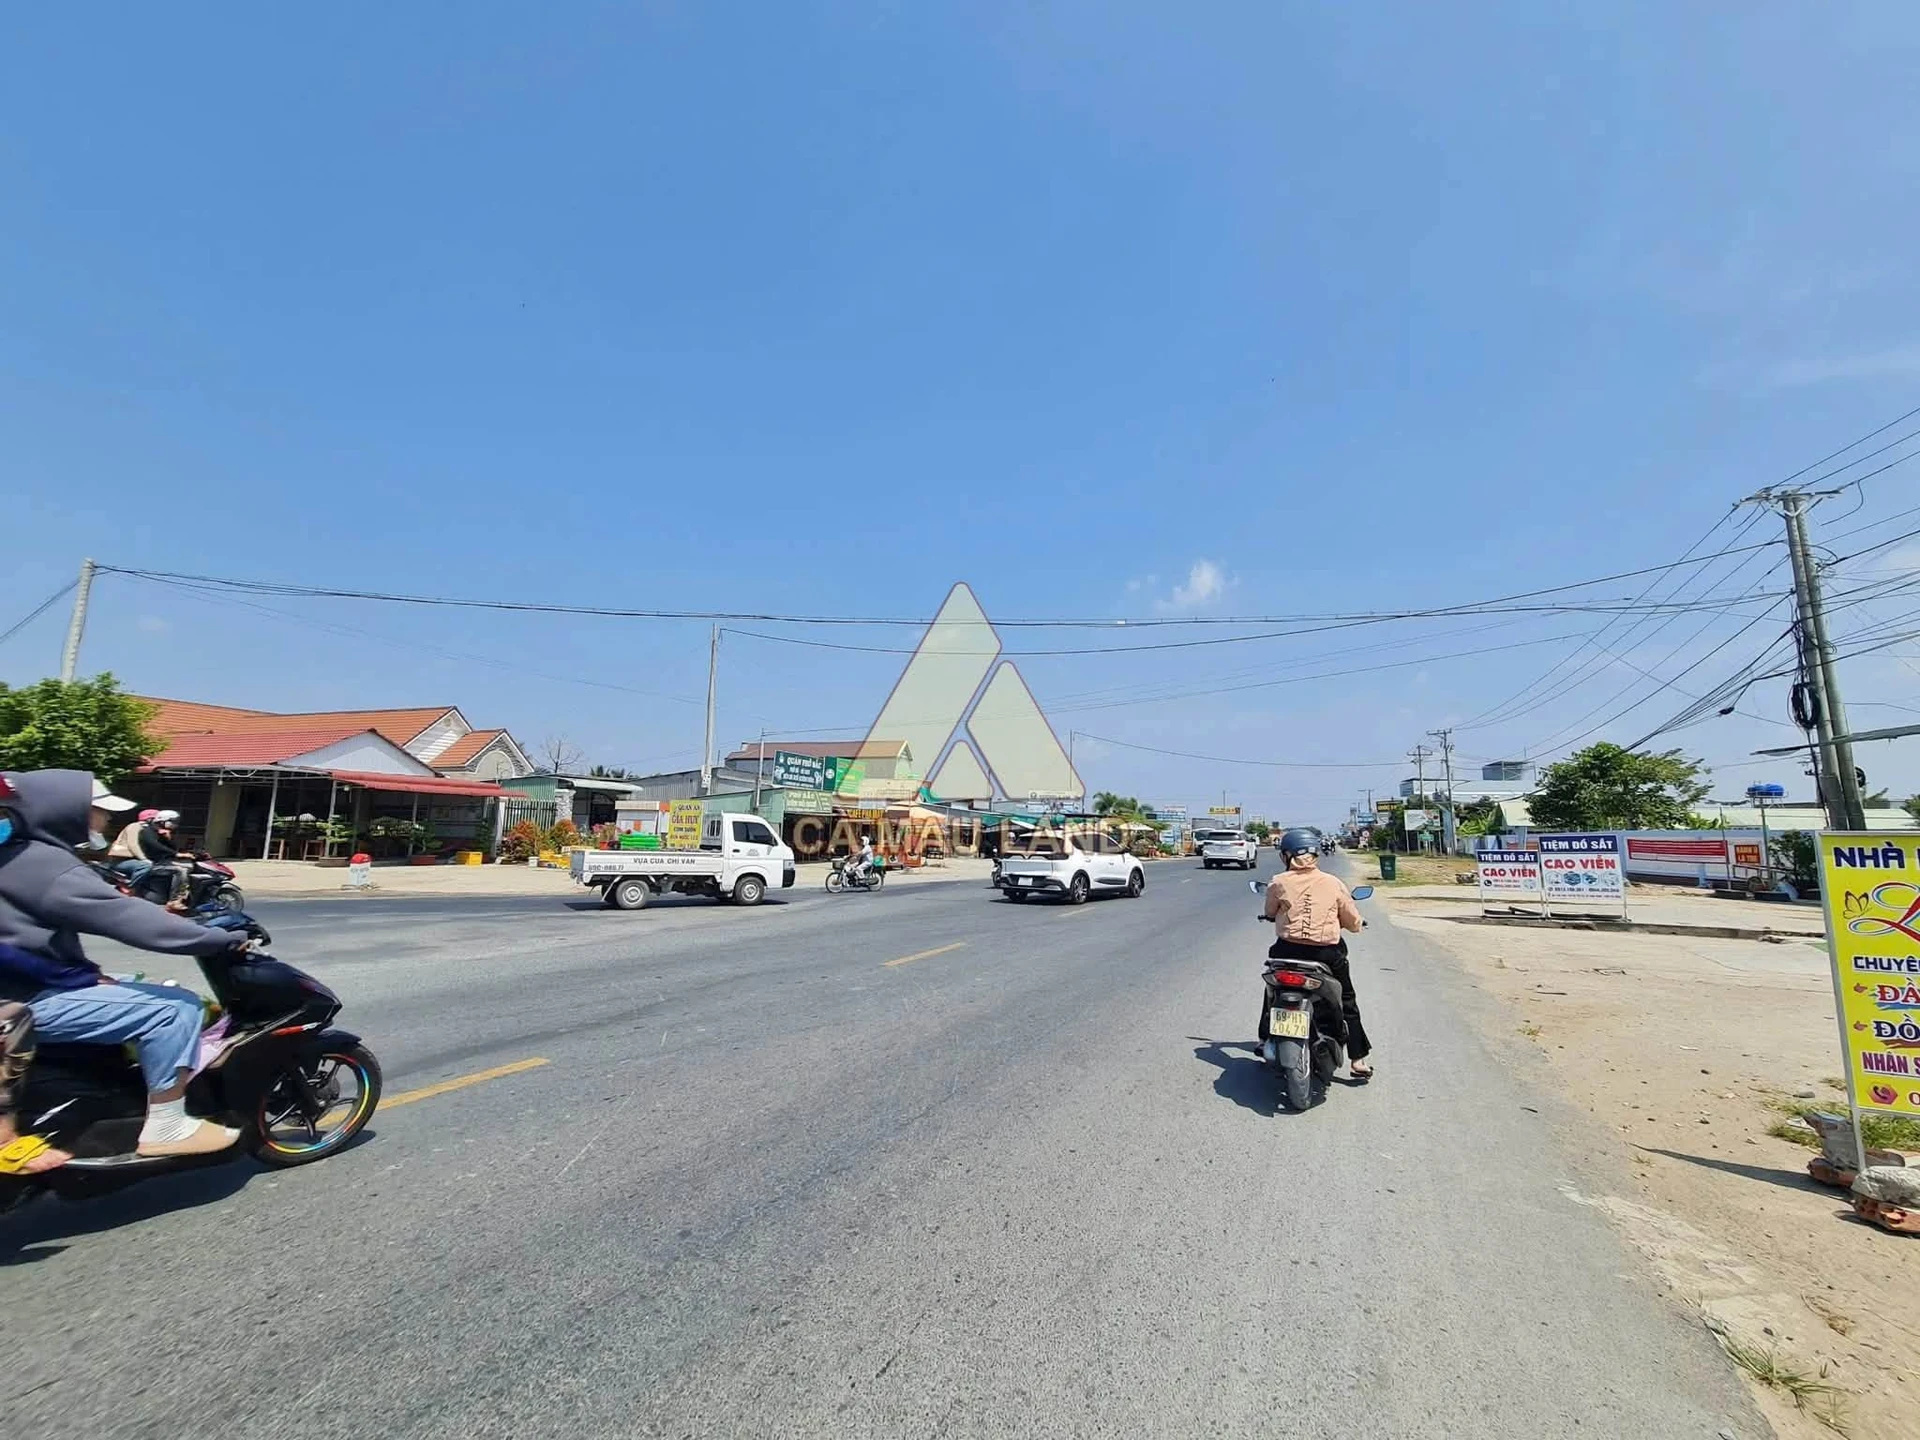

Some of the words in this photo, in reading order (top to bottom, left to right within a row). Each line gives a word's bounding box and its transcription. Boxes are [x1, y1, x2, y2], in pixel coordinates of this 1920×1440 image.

[1541, 839, 1569, 851] TIỆM
[1480, 852, 1502, 862] TIỆM
[1833, 841, 1906, 869] NHÀ
[1543, 859, 1577, 870] CAO
[1482, 868, 1507, 877] CAO
[1853, 955, 1920, 972] CHUYÊ
[1862, 1051, 1909, 1073] NHÂN
